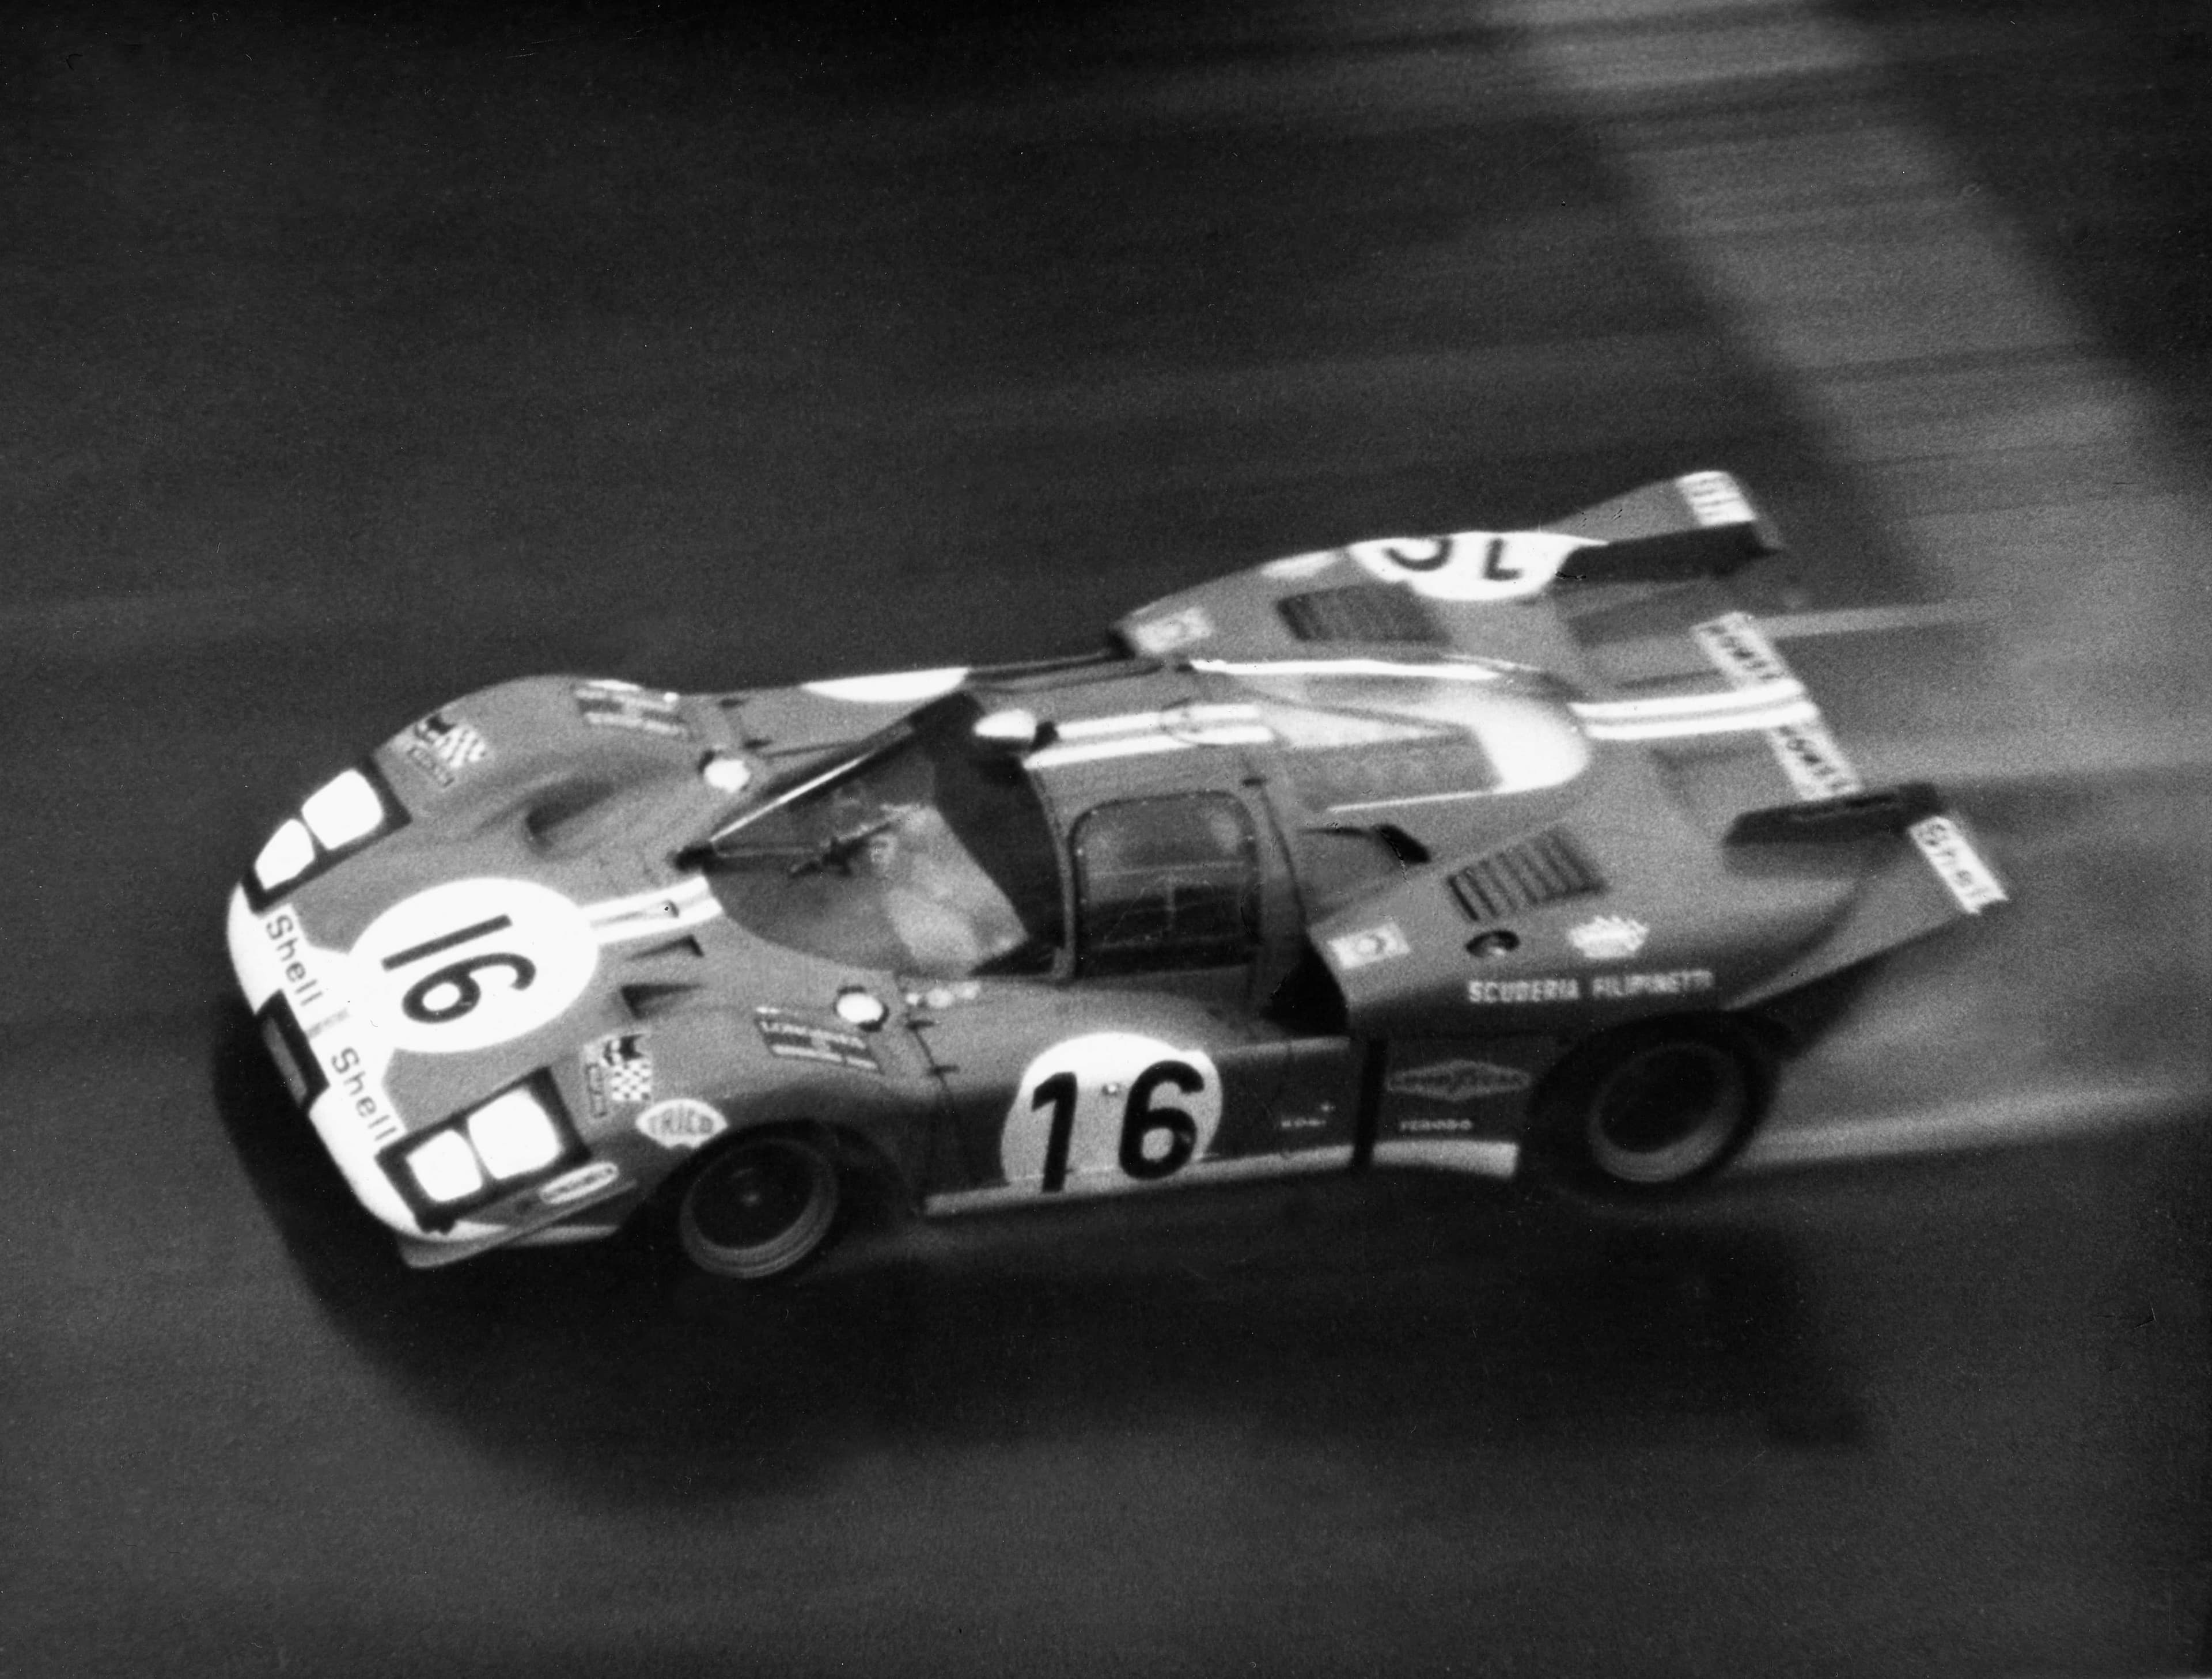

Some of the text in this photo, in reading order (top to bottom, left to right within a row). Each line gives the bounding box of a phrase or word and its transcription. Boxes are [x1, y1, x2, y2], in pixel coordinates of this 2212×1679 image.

[266, 914, 323, 1007] Shell
[381, 914, 537, 1025] 16
[1468, 978, 1581, 1004] SCUDERIA
[331, 1046, 398, 1142] Shell
[1032, 1060, 1205, 1193] 16
